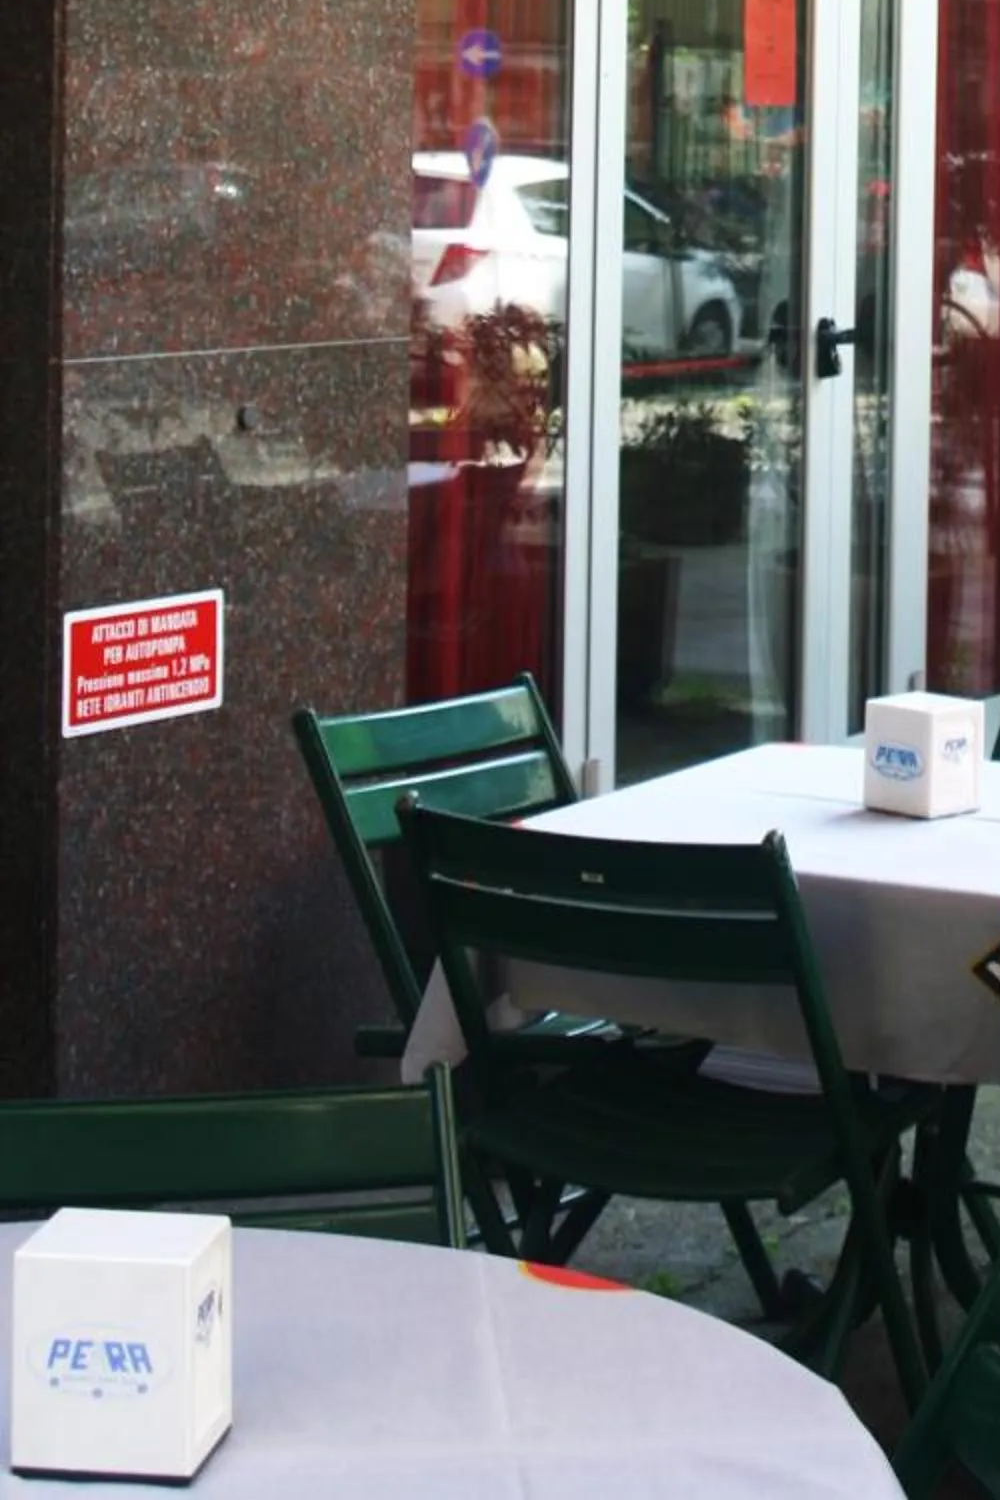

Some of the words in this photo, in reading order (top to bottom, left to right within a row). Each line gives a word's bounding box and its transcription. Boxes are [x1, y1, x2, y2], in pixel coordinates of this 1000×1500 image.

[91, 619, 135, 645] ATTACCO
[137, 616, 149, 638] DI
[150, 609, 198, 635] MANDATA
[103, 644, 123, 666] PER
[125, 634, 187, 662] AUTOPOMPA
[76, 672, 125, 696] Pressione
[76, 696, 102, 719] RETE
[103, 687, 145, 714] IDRANTI
[146, 675, 210, 704] ANTINCENDIO
